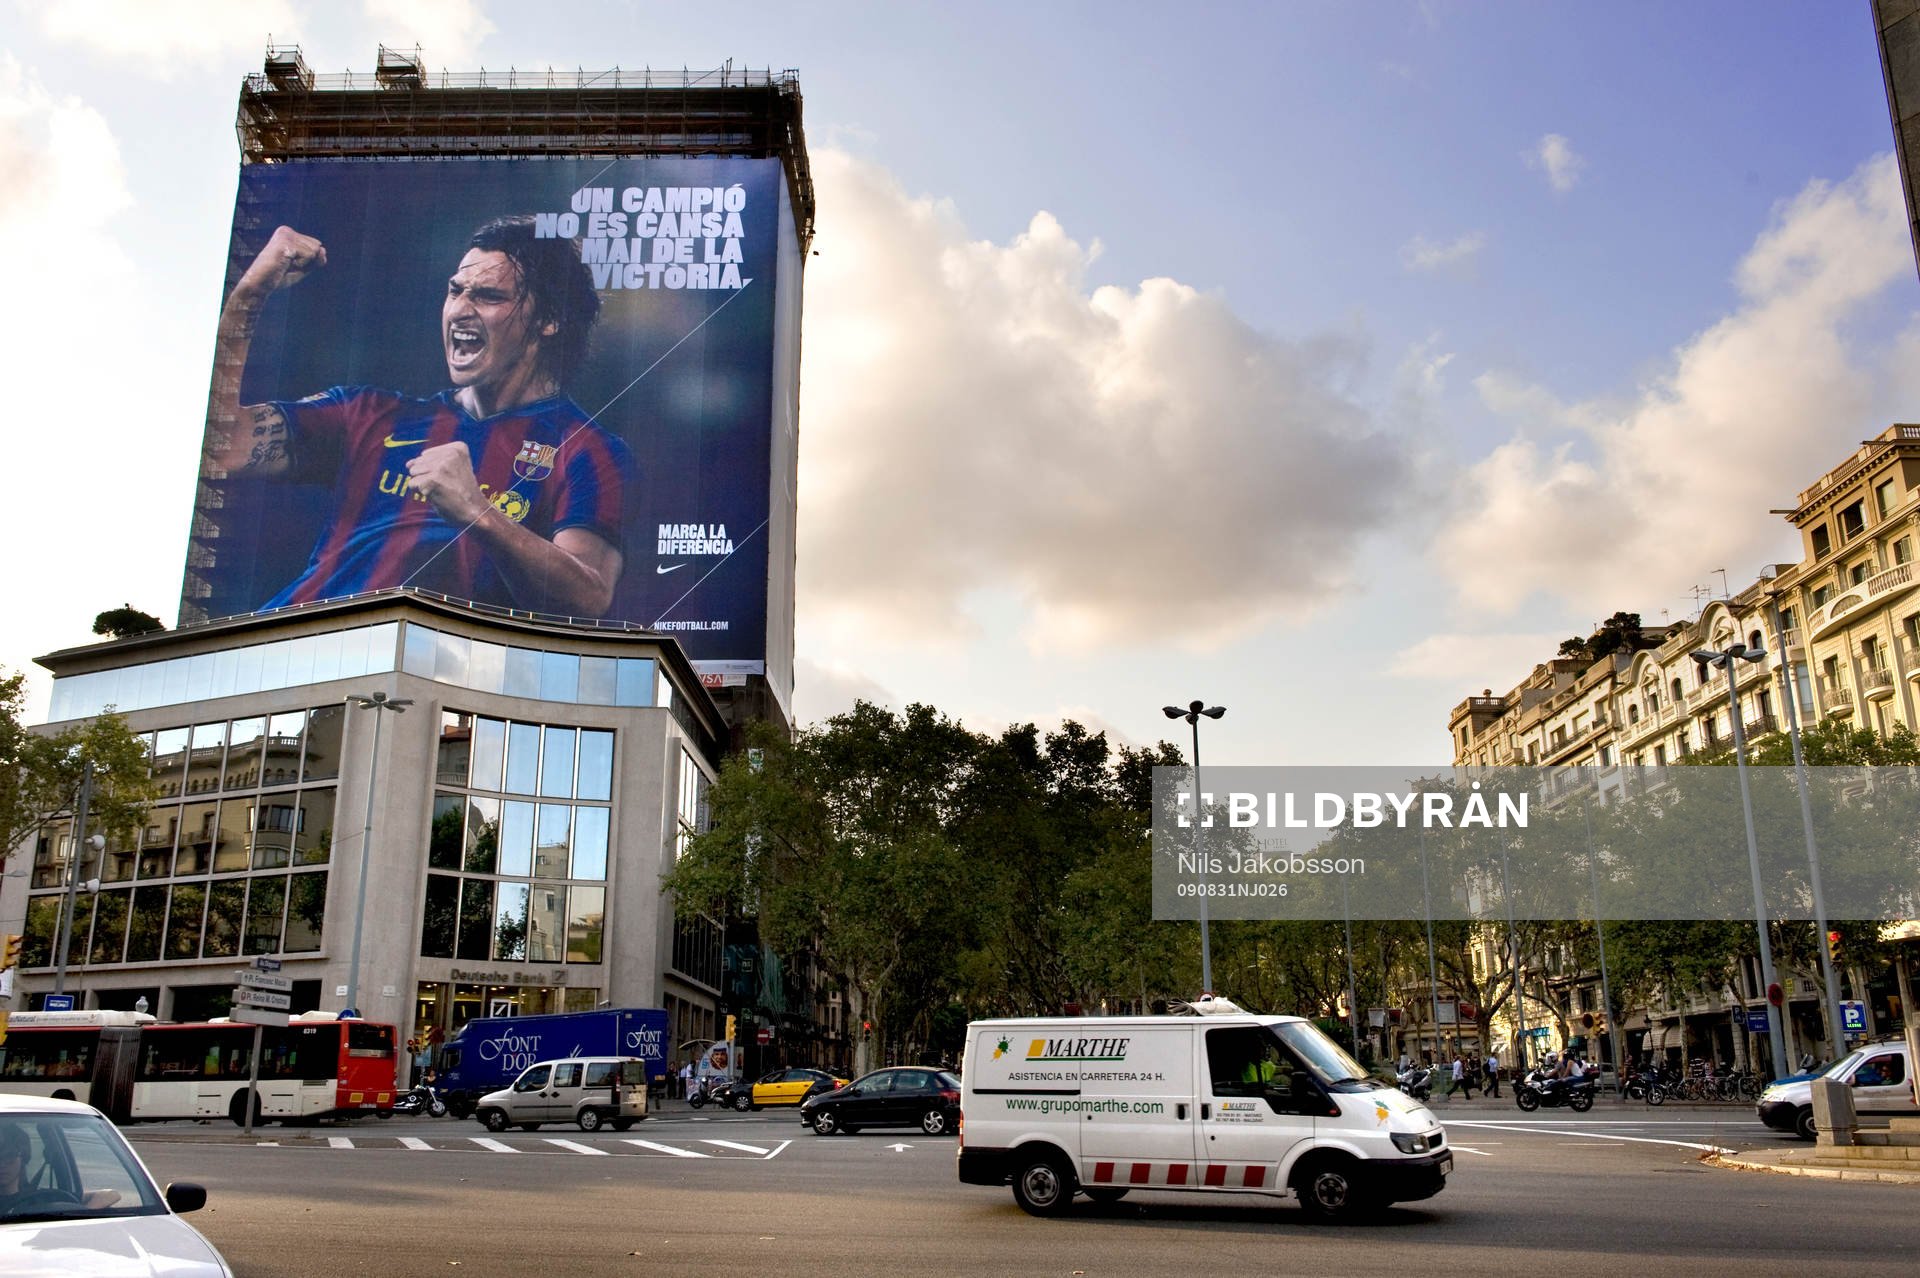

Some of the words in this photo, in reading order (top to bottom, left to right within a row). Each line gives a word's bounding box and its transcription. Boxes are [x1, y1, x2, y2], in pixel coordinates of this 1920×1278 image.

[571, 187, 614, 213] UN
[622, 183, 746, 213] CAMPIÓ
[534, 212, 580, 239] NO
[587, 212, 628, 238] ES
[636, 212, 745, 238] CANSA
[580, 237, 642, 264] MAI
[652, 237, 694, 263] DE
[704, 237, 744, 263] LA
[658, 524, 706, 539] MARCA
[709, 524, 727, 539] LA
[653, 621, 729, 631] NIKEFOOTBALL.COM
[451, 969, 508, 982] Deutsche
[514, 972, 546, 984] Bank
[1845, 1009, 1859, 1023] P
[1044, 1038, 1130, 1057] MARTHE
[1008, 1072, 1063, 1081] ASISTENCIA
[1066, 1073, 1078, 1081] EN
[1081, 1072, 1137, 1081] CARRETERA
[1140, 1073, 1152, 1081] 24
[1155, 1073, 1166, 1081] H.
[1006, 1099, 1164, 1114] www.grupomarthe.com
